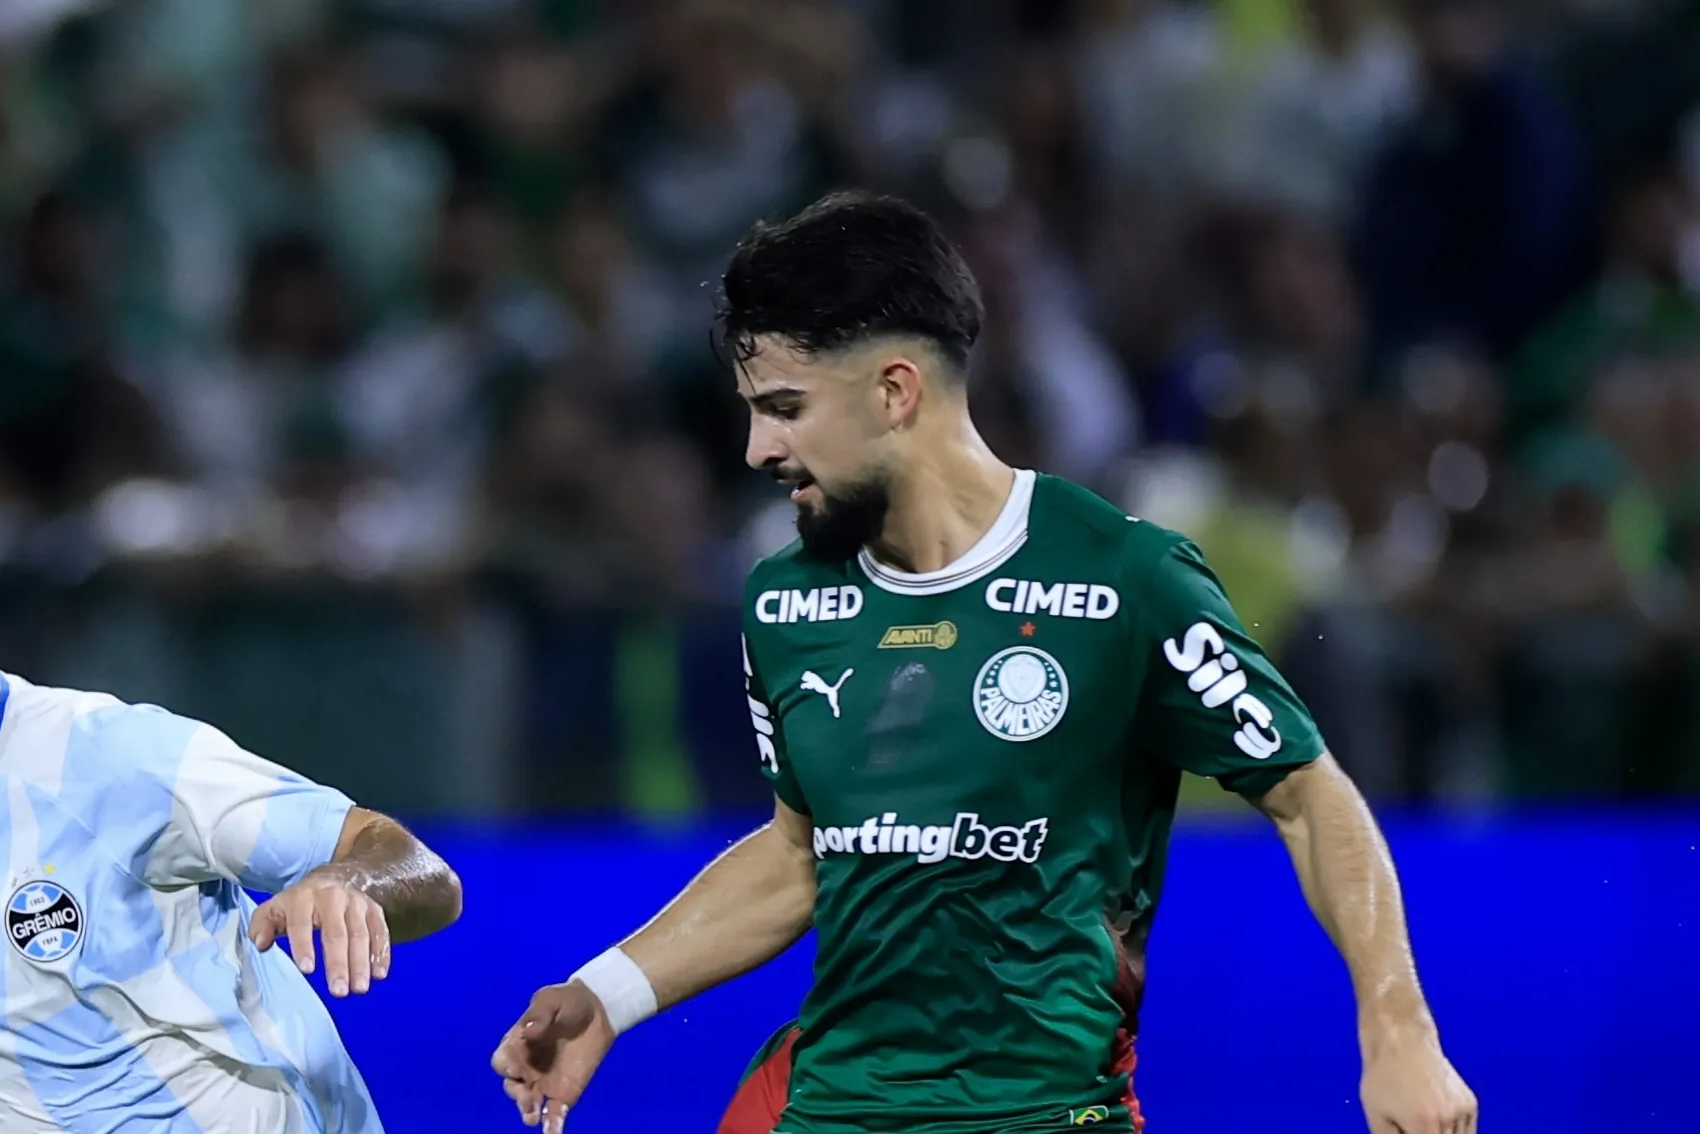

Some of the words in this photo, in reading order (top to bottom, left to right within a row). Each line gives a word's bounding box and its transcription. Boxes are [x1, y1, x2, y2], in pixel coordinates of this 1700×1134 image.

[755, 585, 864, 623] CIMED
[985, 578, 1120, 620] CIMED
[980, 687, 1062, 736] PALMEIRAS
[813, 812, 1049, 864] portingbet
[12, 907, 77, 939] GRÊMIO
